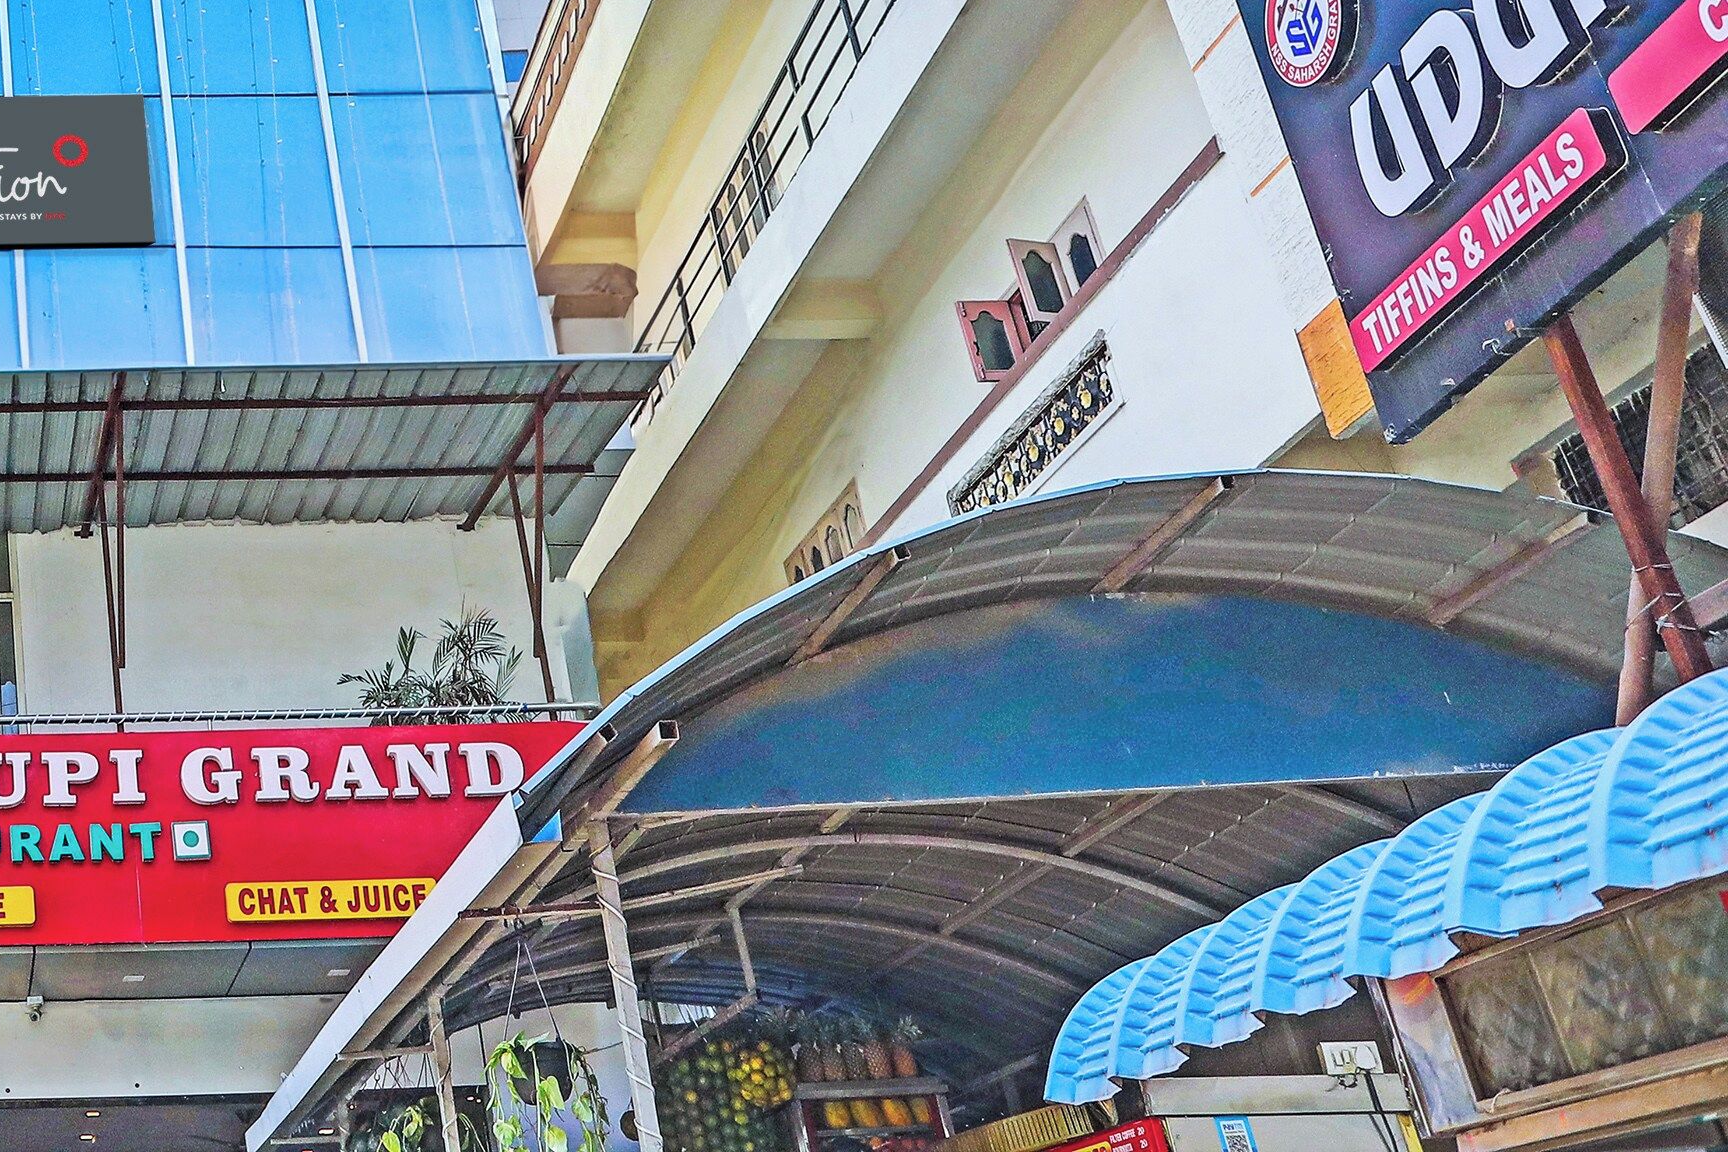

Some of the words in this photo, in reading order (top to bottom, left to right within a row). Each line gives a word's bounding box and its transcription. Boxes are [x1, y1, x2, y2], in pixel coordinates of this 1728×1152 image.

[1271, 43, 1289, 73] NSS
[1287, 43, 1332, 82] SAHARSH
[0, 213, 27, 221] STAYS
[30, 213, 42, 221] BY
[1361, 247, 1459, 356] TIFFINS
[1459, 224, 1486, 269] &
[1483, 130, 1586, 245] MEALS
[180, 742, 526, 805] GRAND
[238, 887, 309, 916] CHAT
[319, 885, 340, 914] &
[346, 882, 427, 914] JUICE
